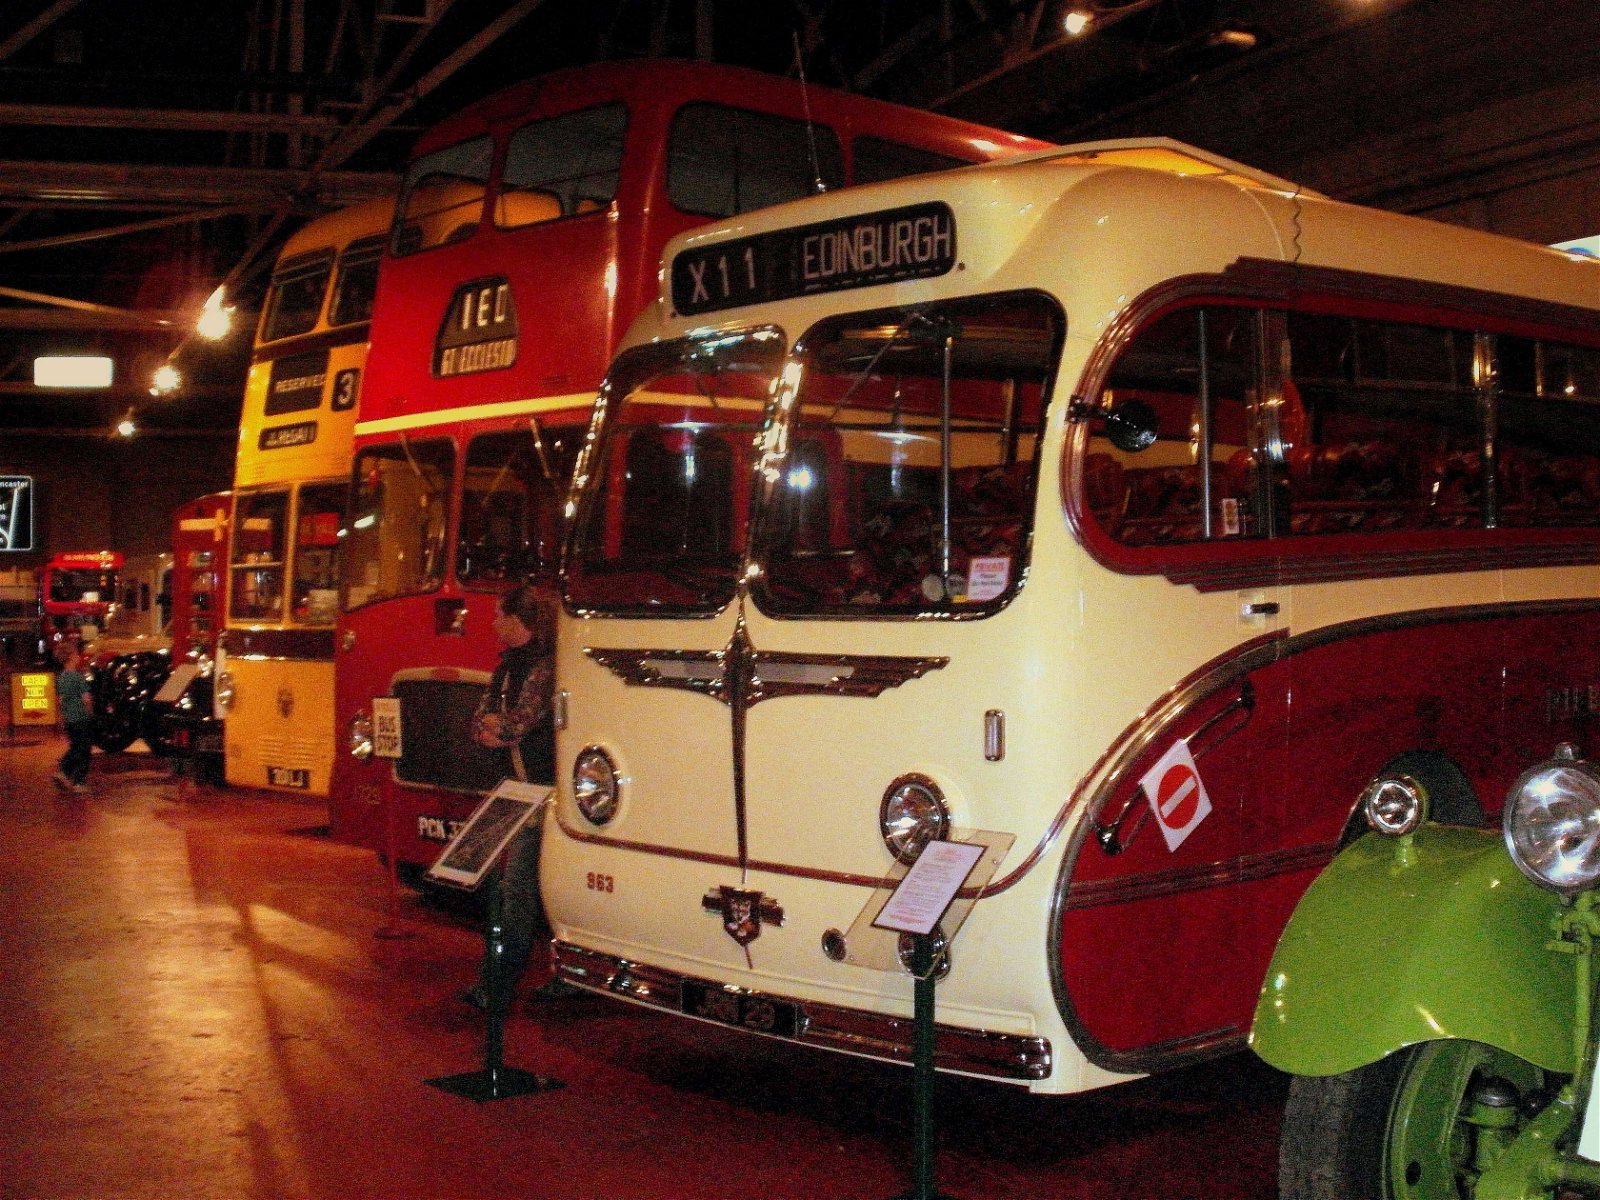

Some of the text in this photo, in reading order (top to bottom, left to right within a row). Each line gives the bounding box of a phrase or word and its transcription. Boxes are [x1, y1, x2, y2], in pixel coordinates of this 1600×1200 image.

[803, 214, 951, 280] EDINBURGH
[338, 372, 355, 405] 3
[23, 699, 48, 708] OPEN
